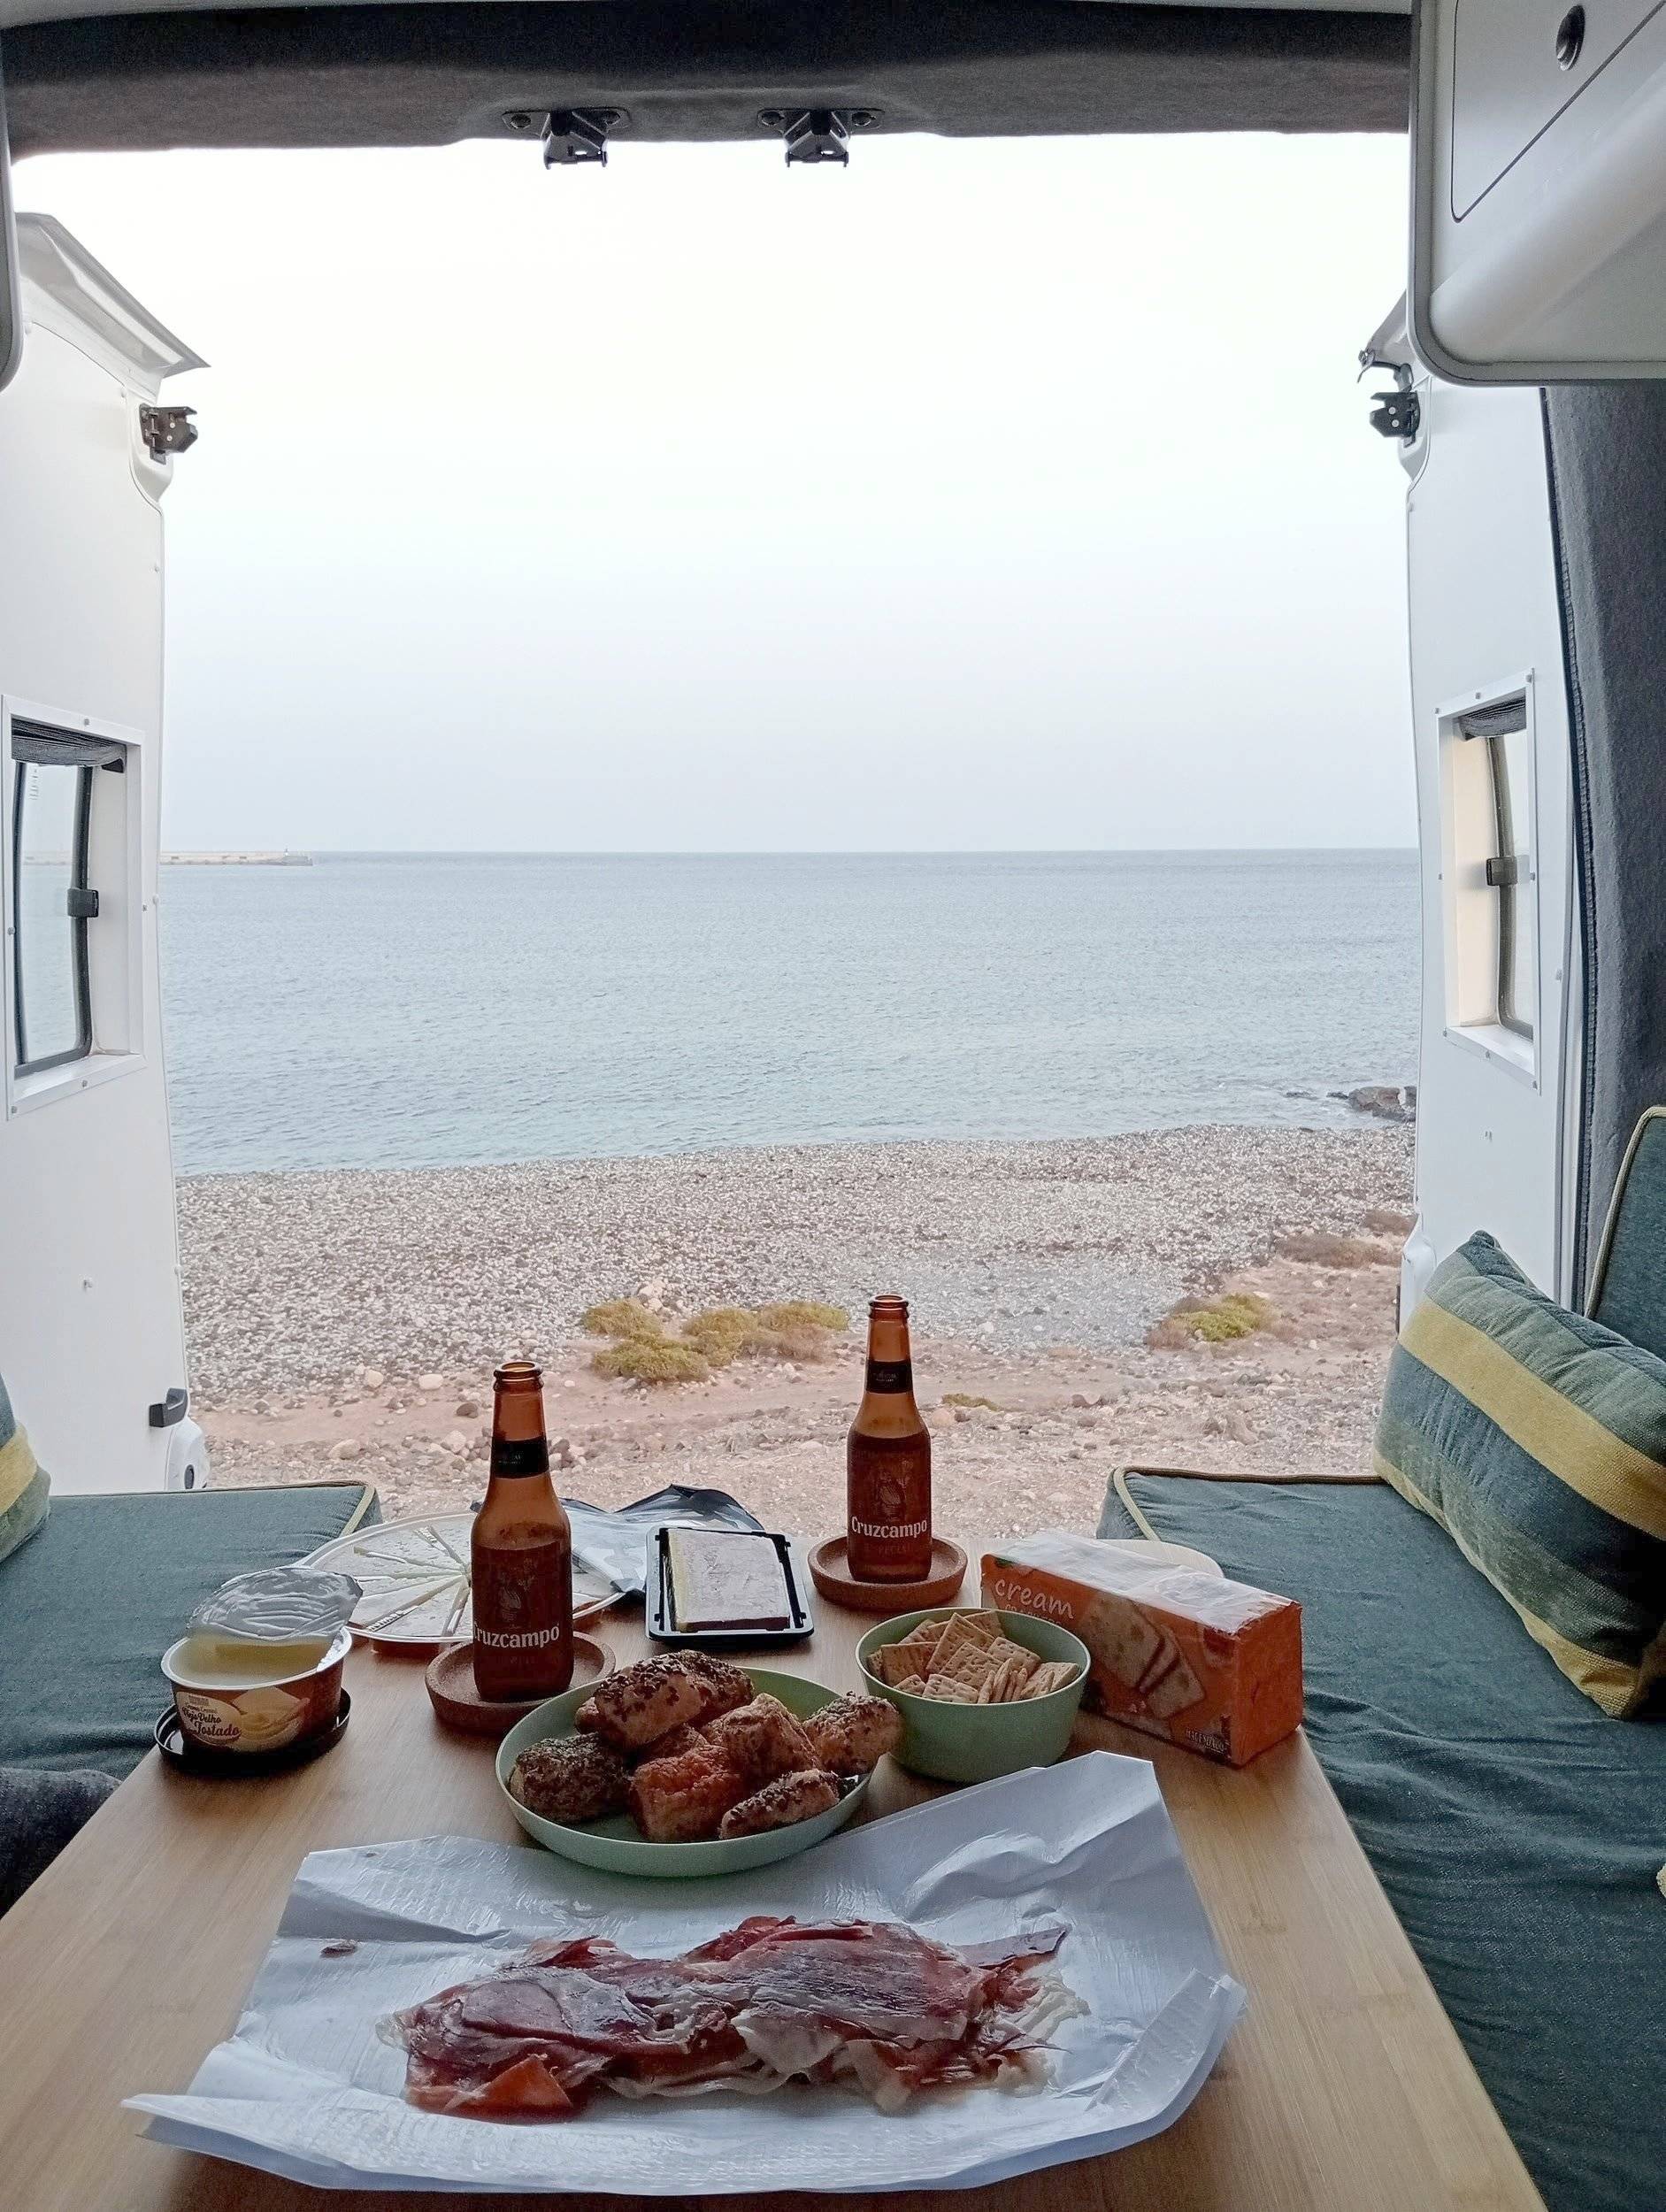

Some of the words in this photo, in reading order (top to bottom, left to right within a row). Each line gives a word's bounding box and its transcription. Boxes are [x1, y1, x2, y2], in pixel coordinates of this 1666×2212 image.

[851, 1516, 927, 1539] Cruzcampo
[994, 1578, 1074, 1619] cream
[194, 1721, 239, 1737] Tostado
